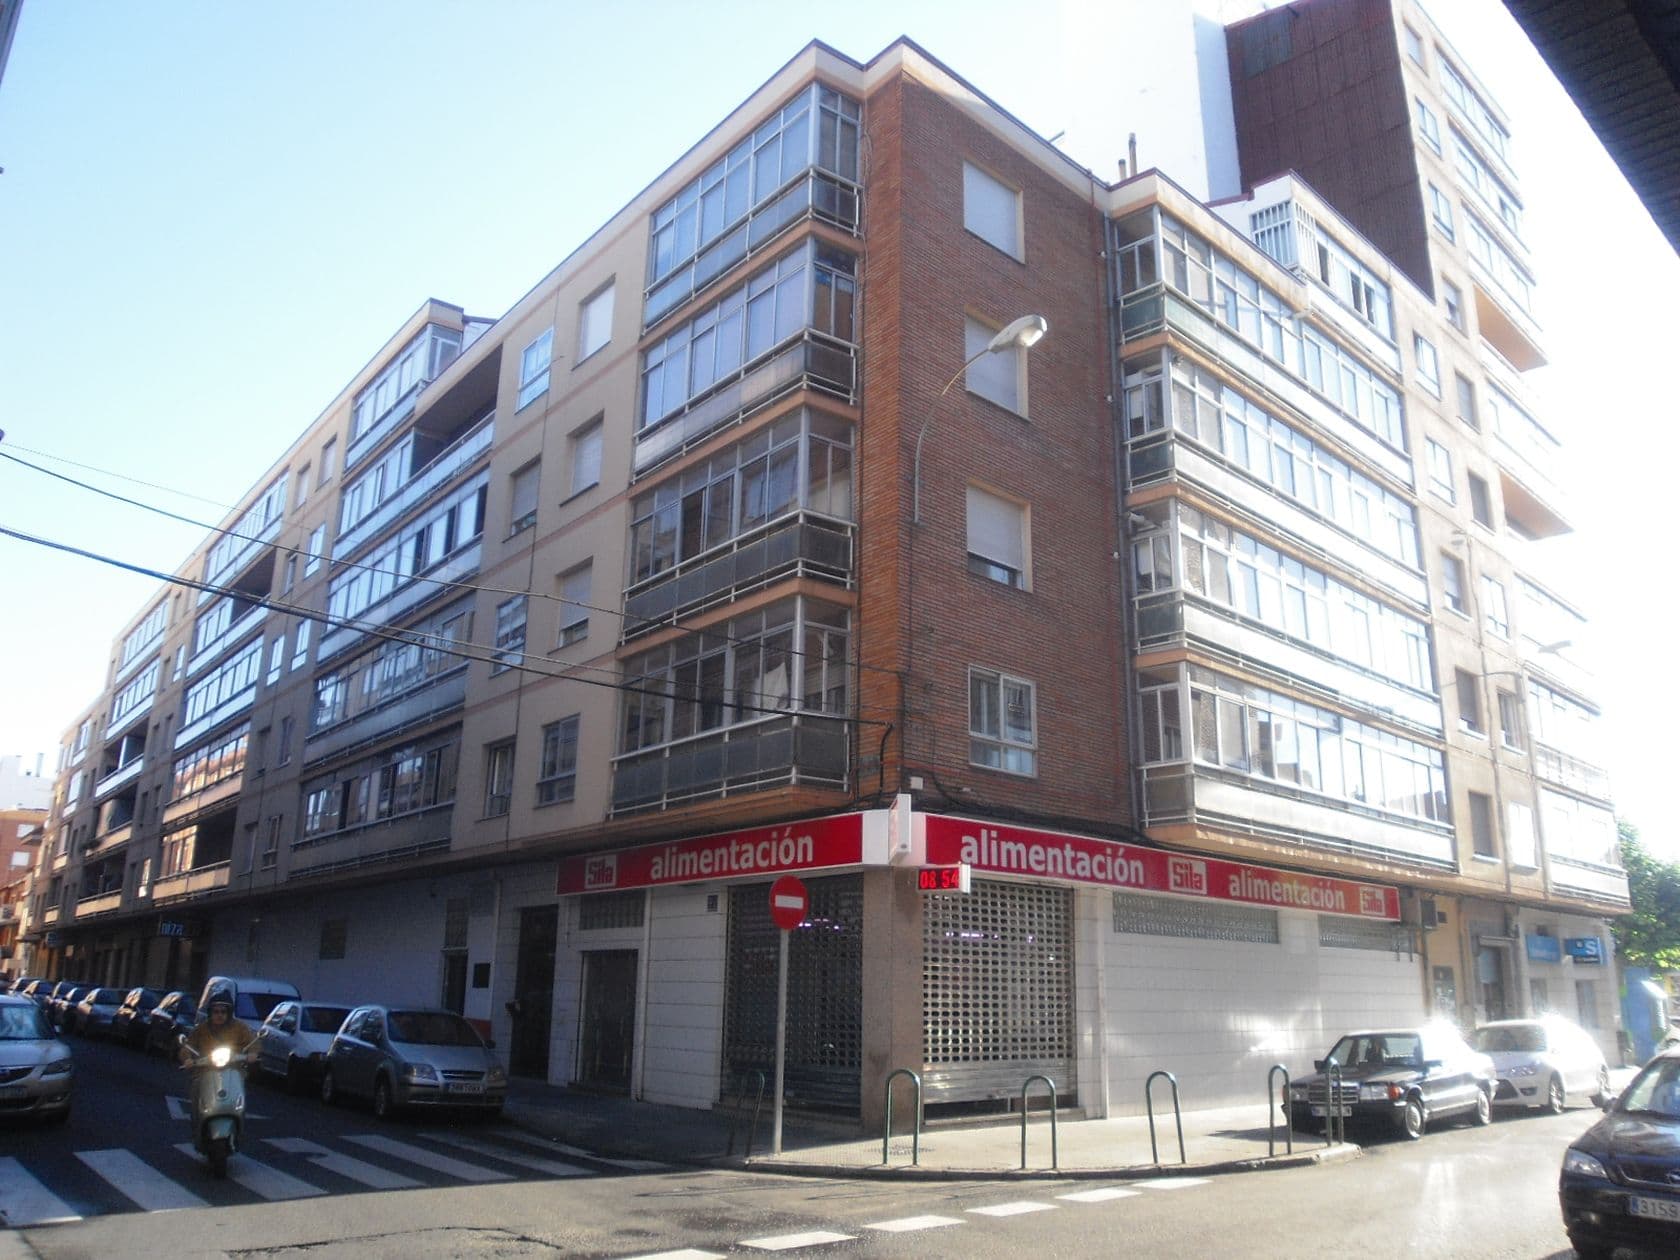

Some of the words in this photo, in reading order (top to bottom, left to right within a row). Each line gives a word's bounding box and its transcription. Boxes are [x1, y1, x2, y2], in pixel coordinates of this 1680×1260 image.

[650, 827, 813, 881] alimentación
[960, 830, 1144, 885] alimentación
[1228, 868, 1345, 911] alimentación
